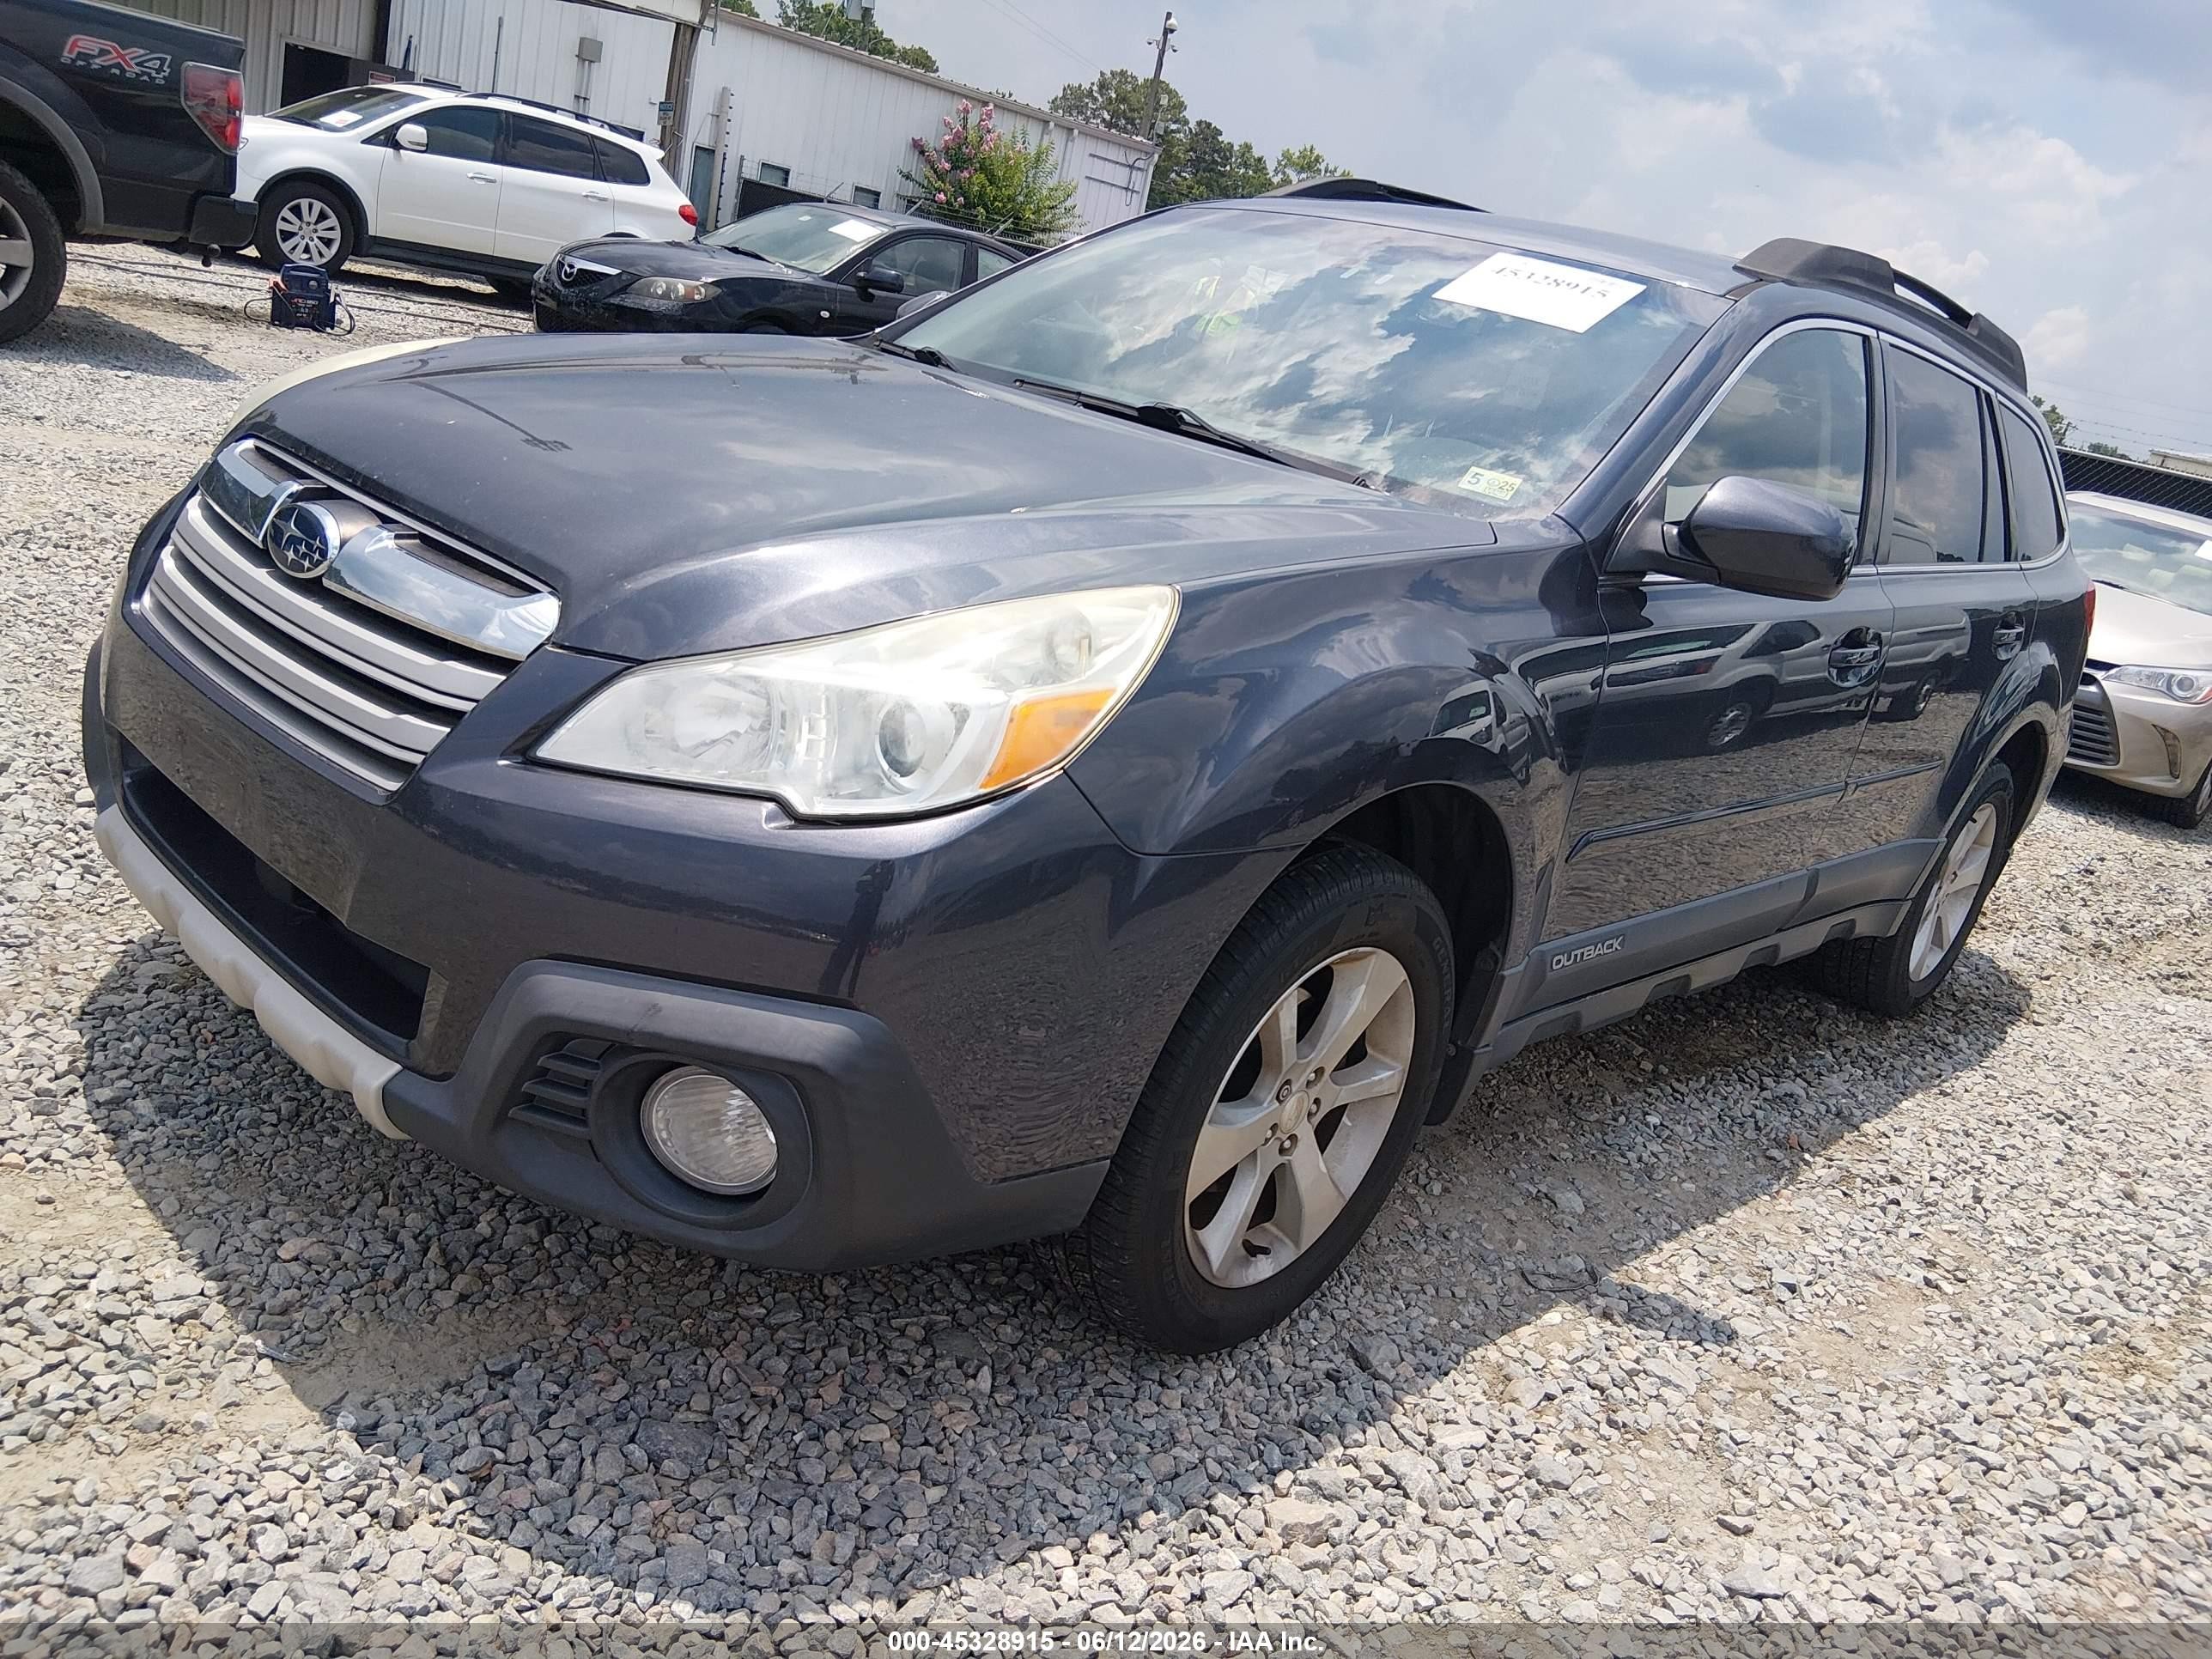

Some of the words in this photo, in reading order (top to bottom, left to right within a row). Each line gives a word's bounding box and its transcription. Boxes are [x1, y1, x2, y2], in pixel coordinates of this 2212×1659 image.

[60, 57, 102, 70] OFF
[110, 68, 165, 84] ROAD
[62, 34, 172, 78] FX4
[1467, 472, 1484, 485] 5
[1498, 480, 1516, 492] 25
[1552, 935, 1625, 970] OUTBACK
